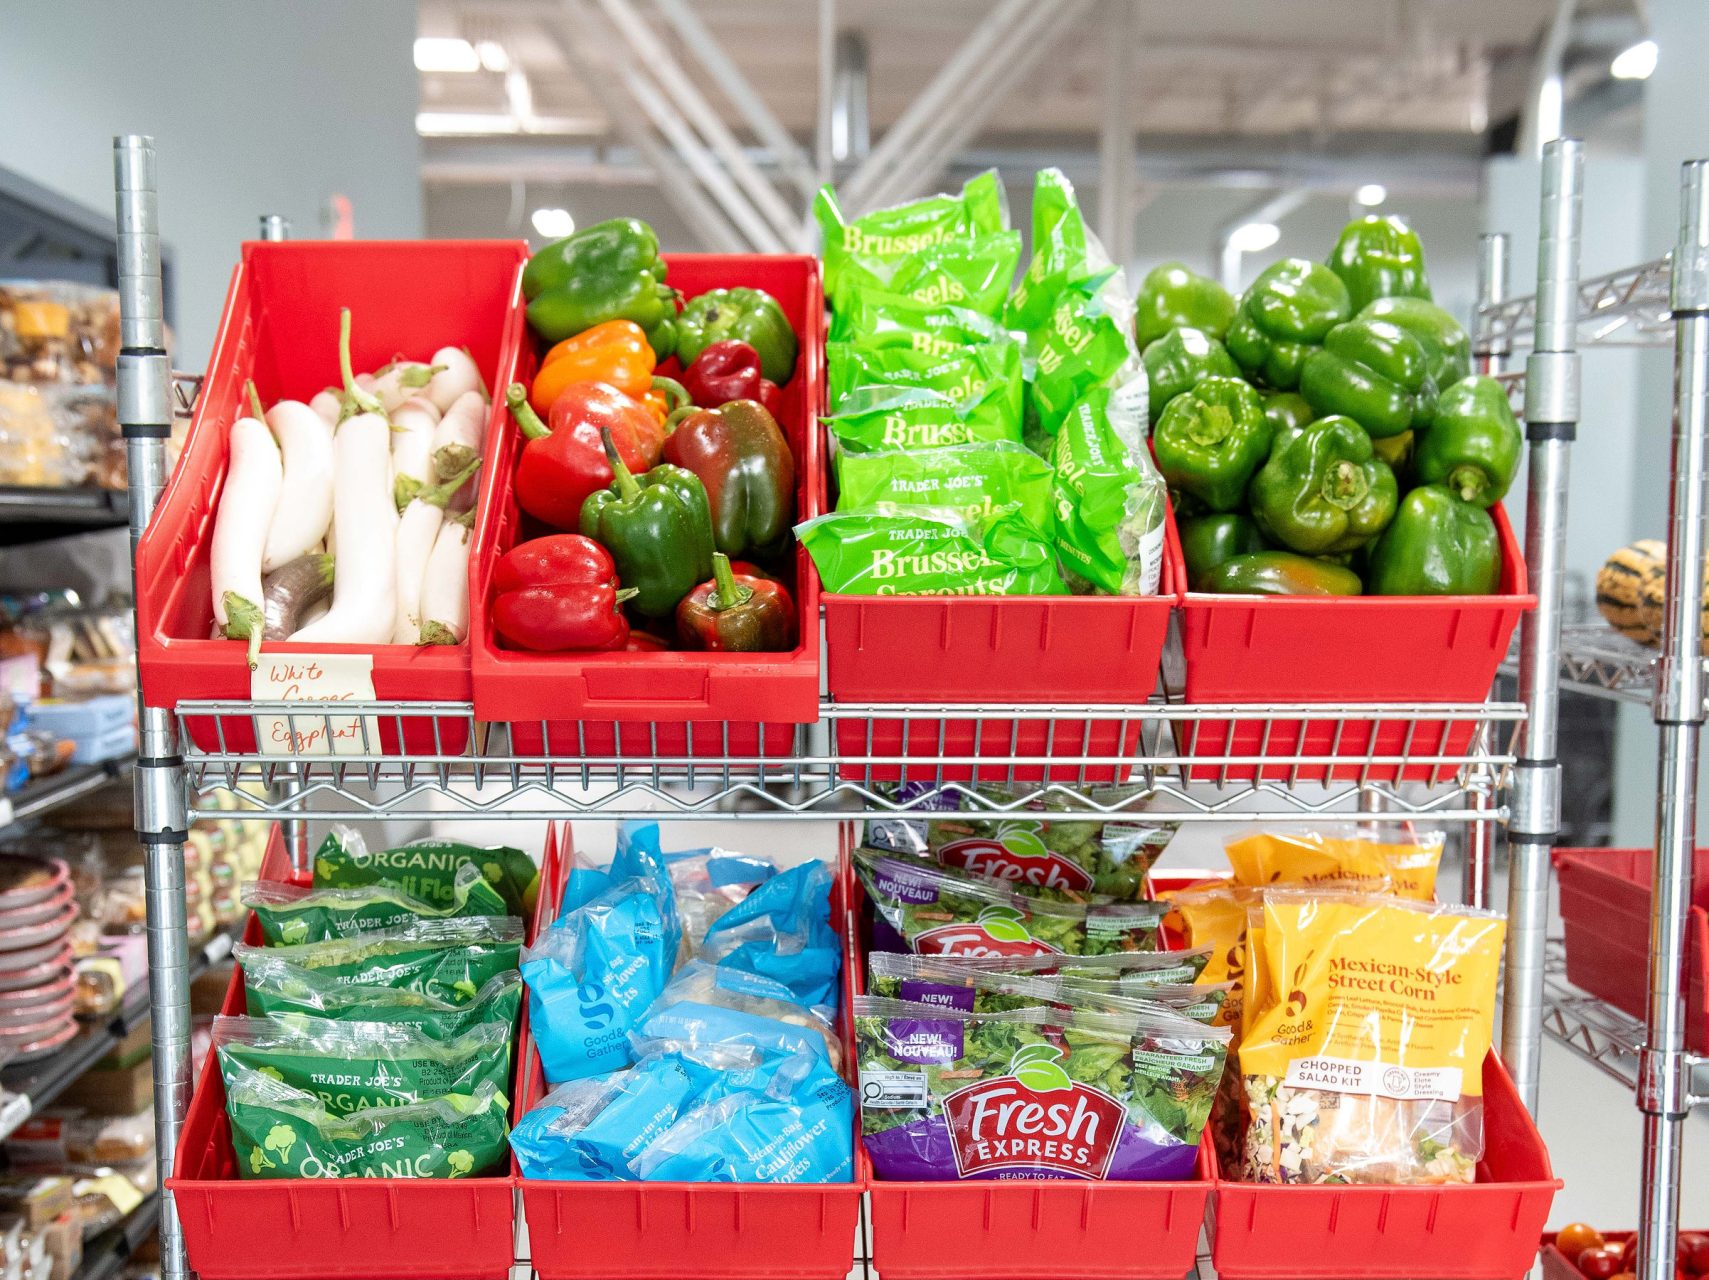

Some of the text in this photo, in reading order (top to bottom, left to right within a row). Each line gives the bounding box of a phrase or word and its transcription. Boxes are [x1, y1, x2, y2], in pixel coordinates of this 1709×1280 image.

[891, 475, 984, 492] TRADER JOE'S
[889, 528, 938, 541] TRADER
[870, 549, 1003, 579] Brussel
[270, 662, 324, 683] White
[353, 852, 472, 872] ORGANIC
[878, 880, 934, 901] NOUVEAU!
[386, 912, 420, 926] JOE'S
[389, 965, 422, 979] JOE'S
[1328, 957, 1463, 988] Mexican-Style
[1328, 973, 1436, 1001] Street Corn
[921, 994, 954, 1005] NEW!
[909, 1034, 942, 1045] NEW!
[586, 1042, 626, 1059] Gather
[893, 1046, 958, 1057] NOUVEAU!
[412, 1060, 428, 1068] USE
[1176, 1062, 1213, 1071] GARANTIE
[1300, 1061, 1362, 1075] CHOPPED
[310, 1073, 403, 1088] TRADER JOE'S
[1299, 1072, 1362, 1087] SALAD KIT
[1414, 1089, 1444, 1097] Dressing
[969, 1088, 1100, 1146] Fresh
[367, 1136, 406, 1153] JOE'S
[755, 1119, 827, 1180] Cauliflower
[977, 1139, 1090, 1167] EXPRESS
[299, 1153, 434, 1178] ORANIC
[771, 1157, 811, 1183] lorets
[1033, 1172, 1045, 1180] TO
